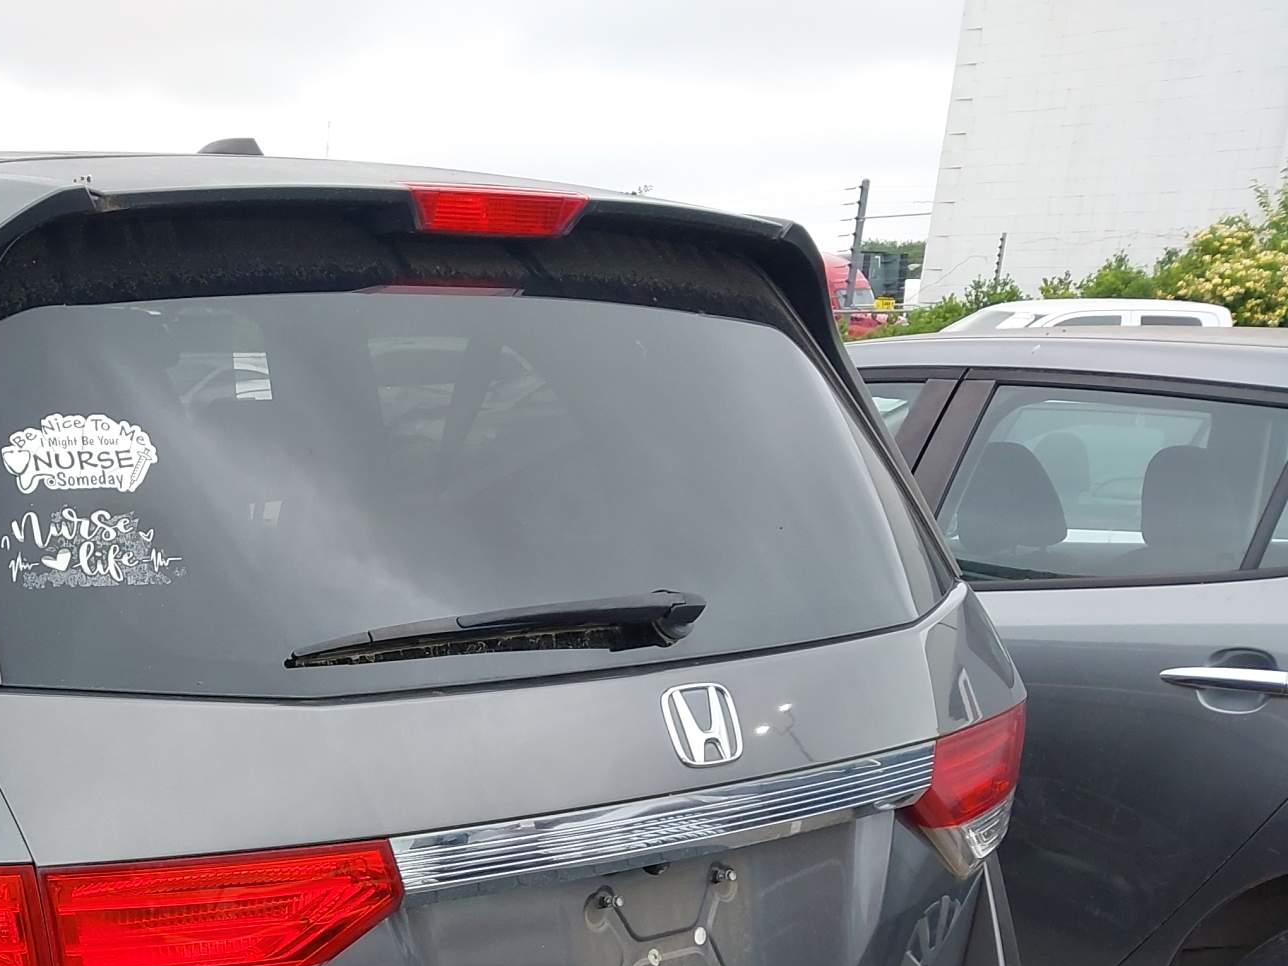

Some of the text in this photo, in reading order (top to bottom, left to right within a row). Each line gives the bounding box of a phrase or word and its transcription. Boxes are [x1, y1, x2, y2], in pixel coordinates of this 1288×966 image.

[13, 417, 147, 448] Be Nice To Me
[40, 436, 119, 449] I Might Be Your
[32, 449, 134, 472] NURSE
[56, 470, 124, 488] Someday
[74, 541, 139, 582] life
